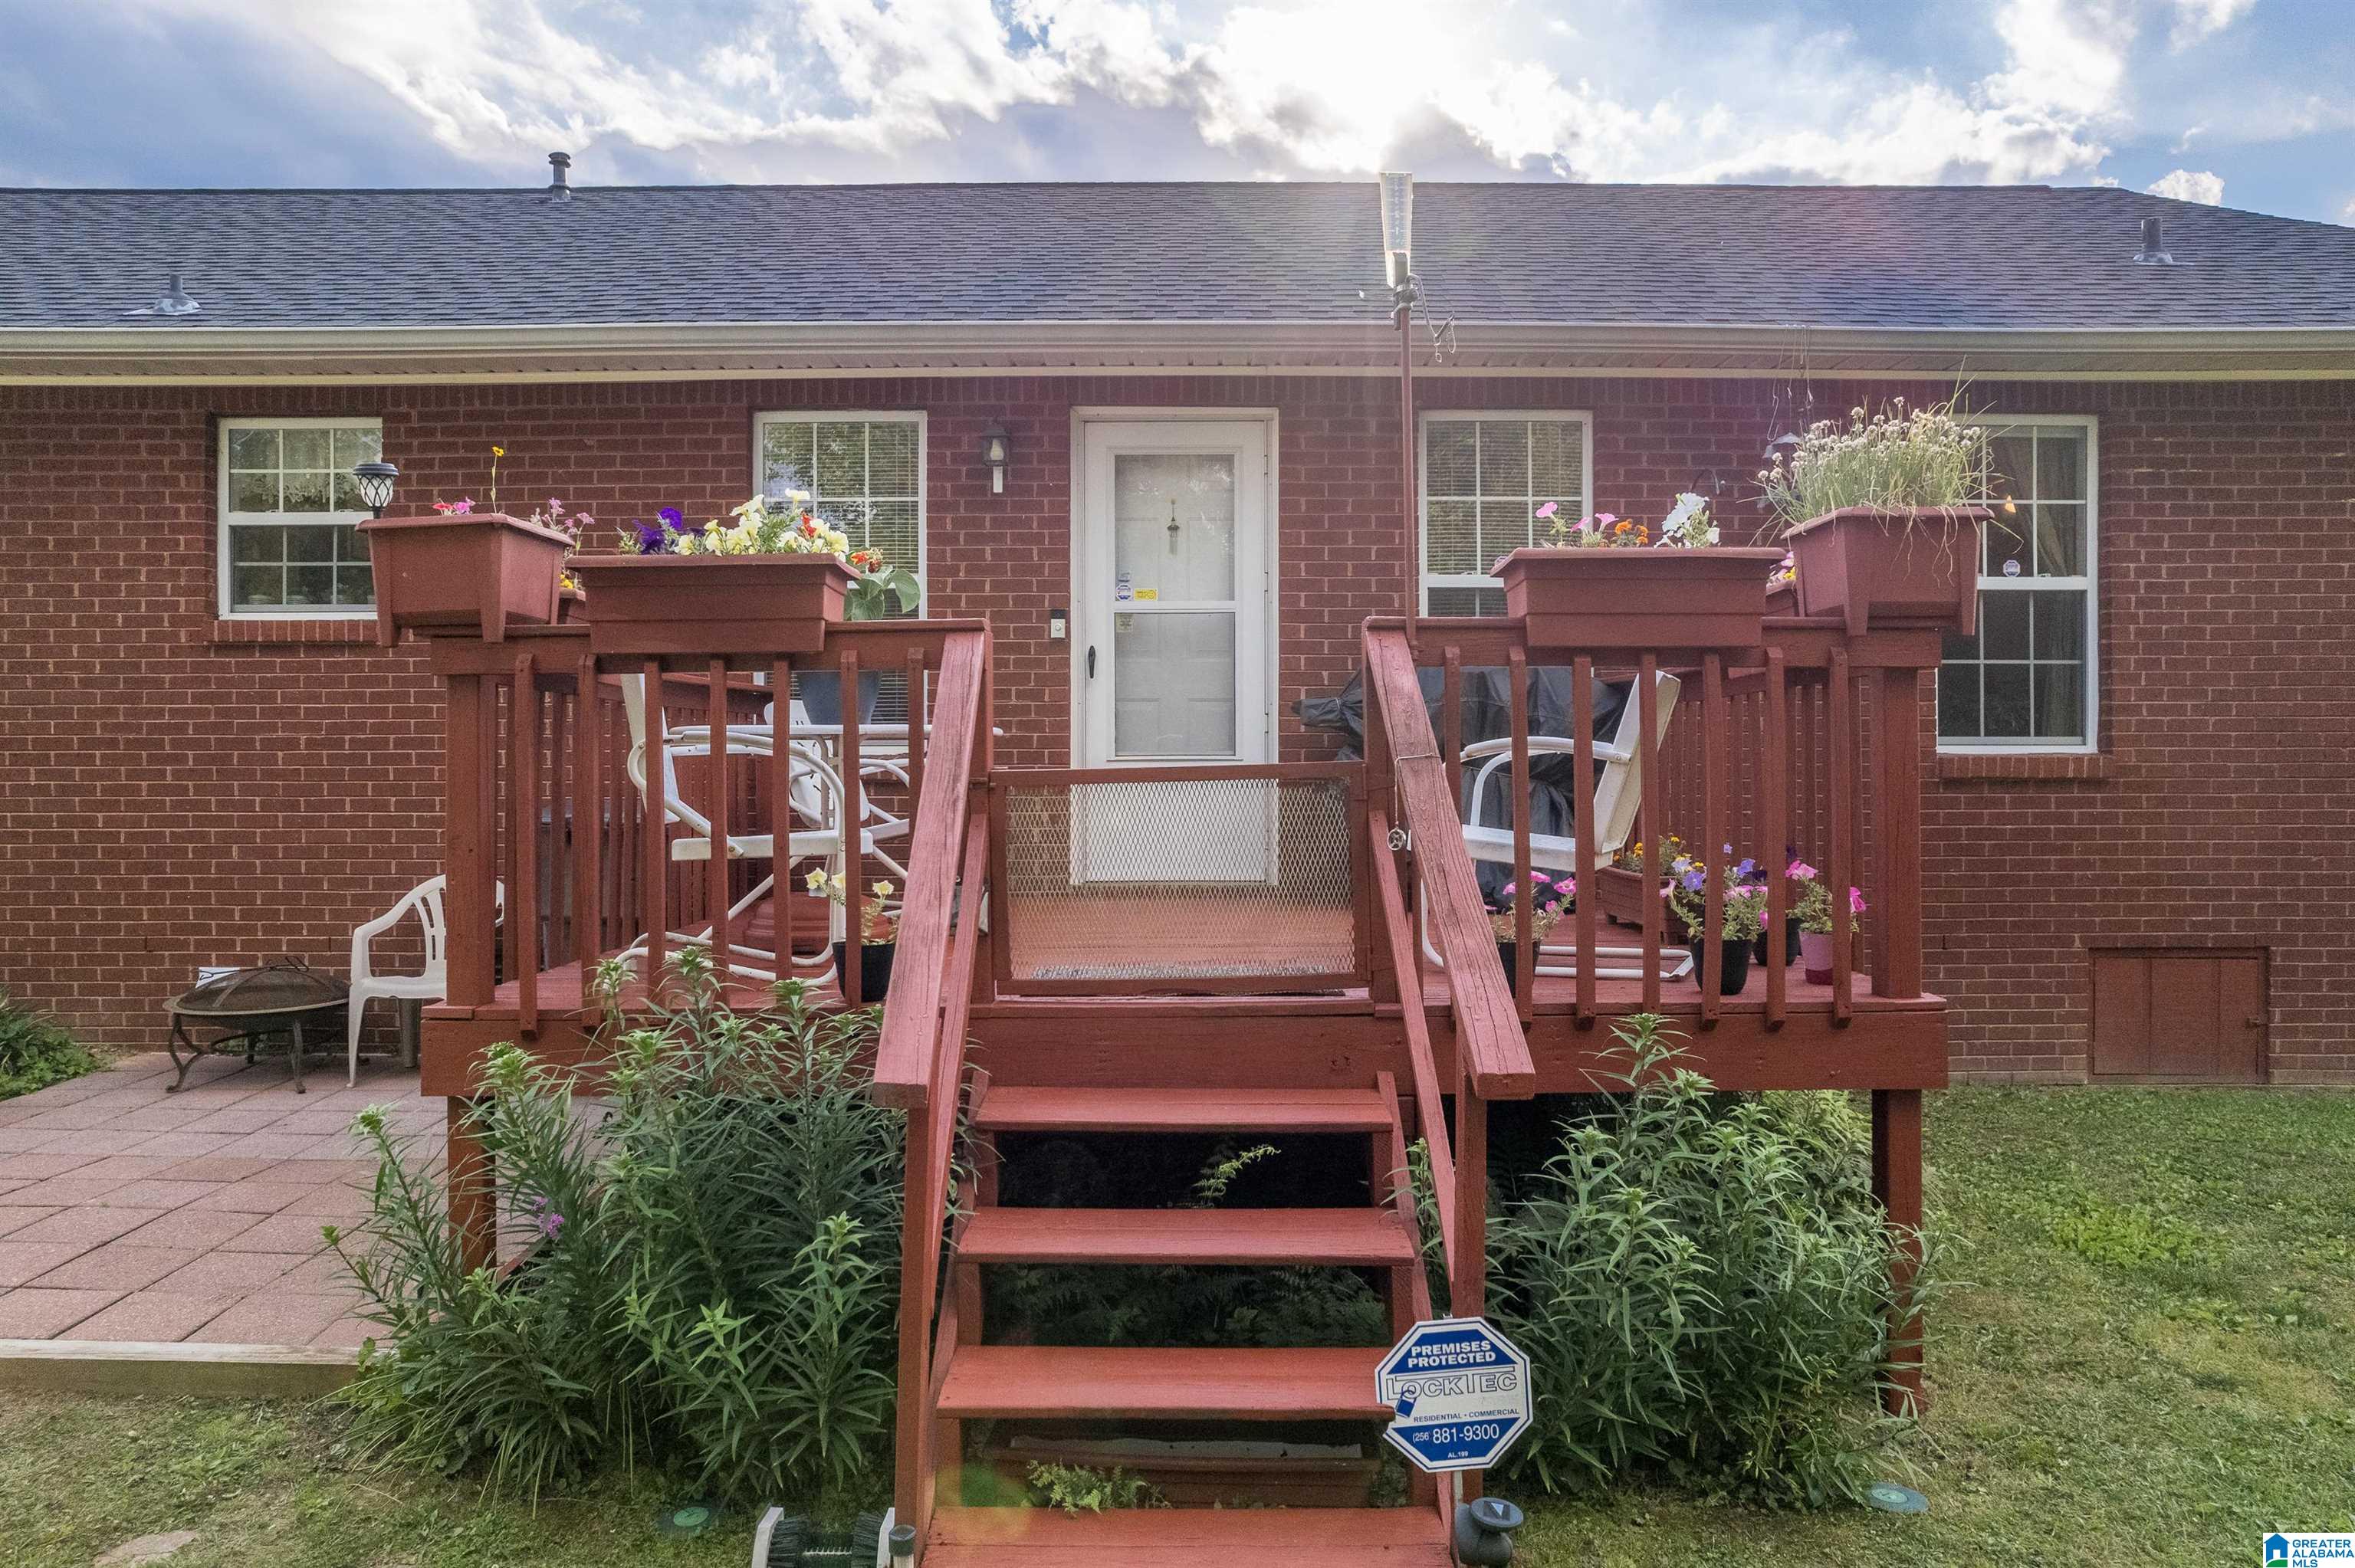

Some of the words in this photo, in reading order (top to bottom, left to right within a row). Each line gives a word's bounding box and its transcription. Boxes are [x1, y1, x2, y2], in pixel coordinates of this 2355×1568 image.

[1411, 1340, 1491, 1356] PREMISES
[1407, 1351, 1496, 1368] PROTECTED
[1386, 1366, 1517, 1400] LOCKTEC
[1414, 1412, 1462, 1423] RESIDENTIAL
[1469, 1409, 1519, 1419] COMMERCIAL
[1433, 1423, 1499, 1444] 881-9300
